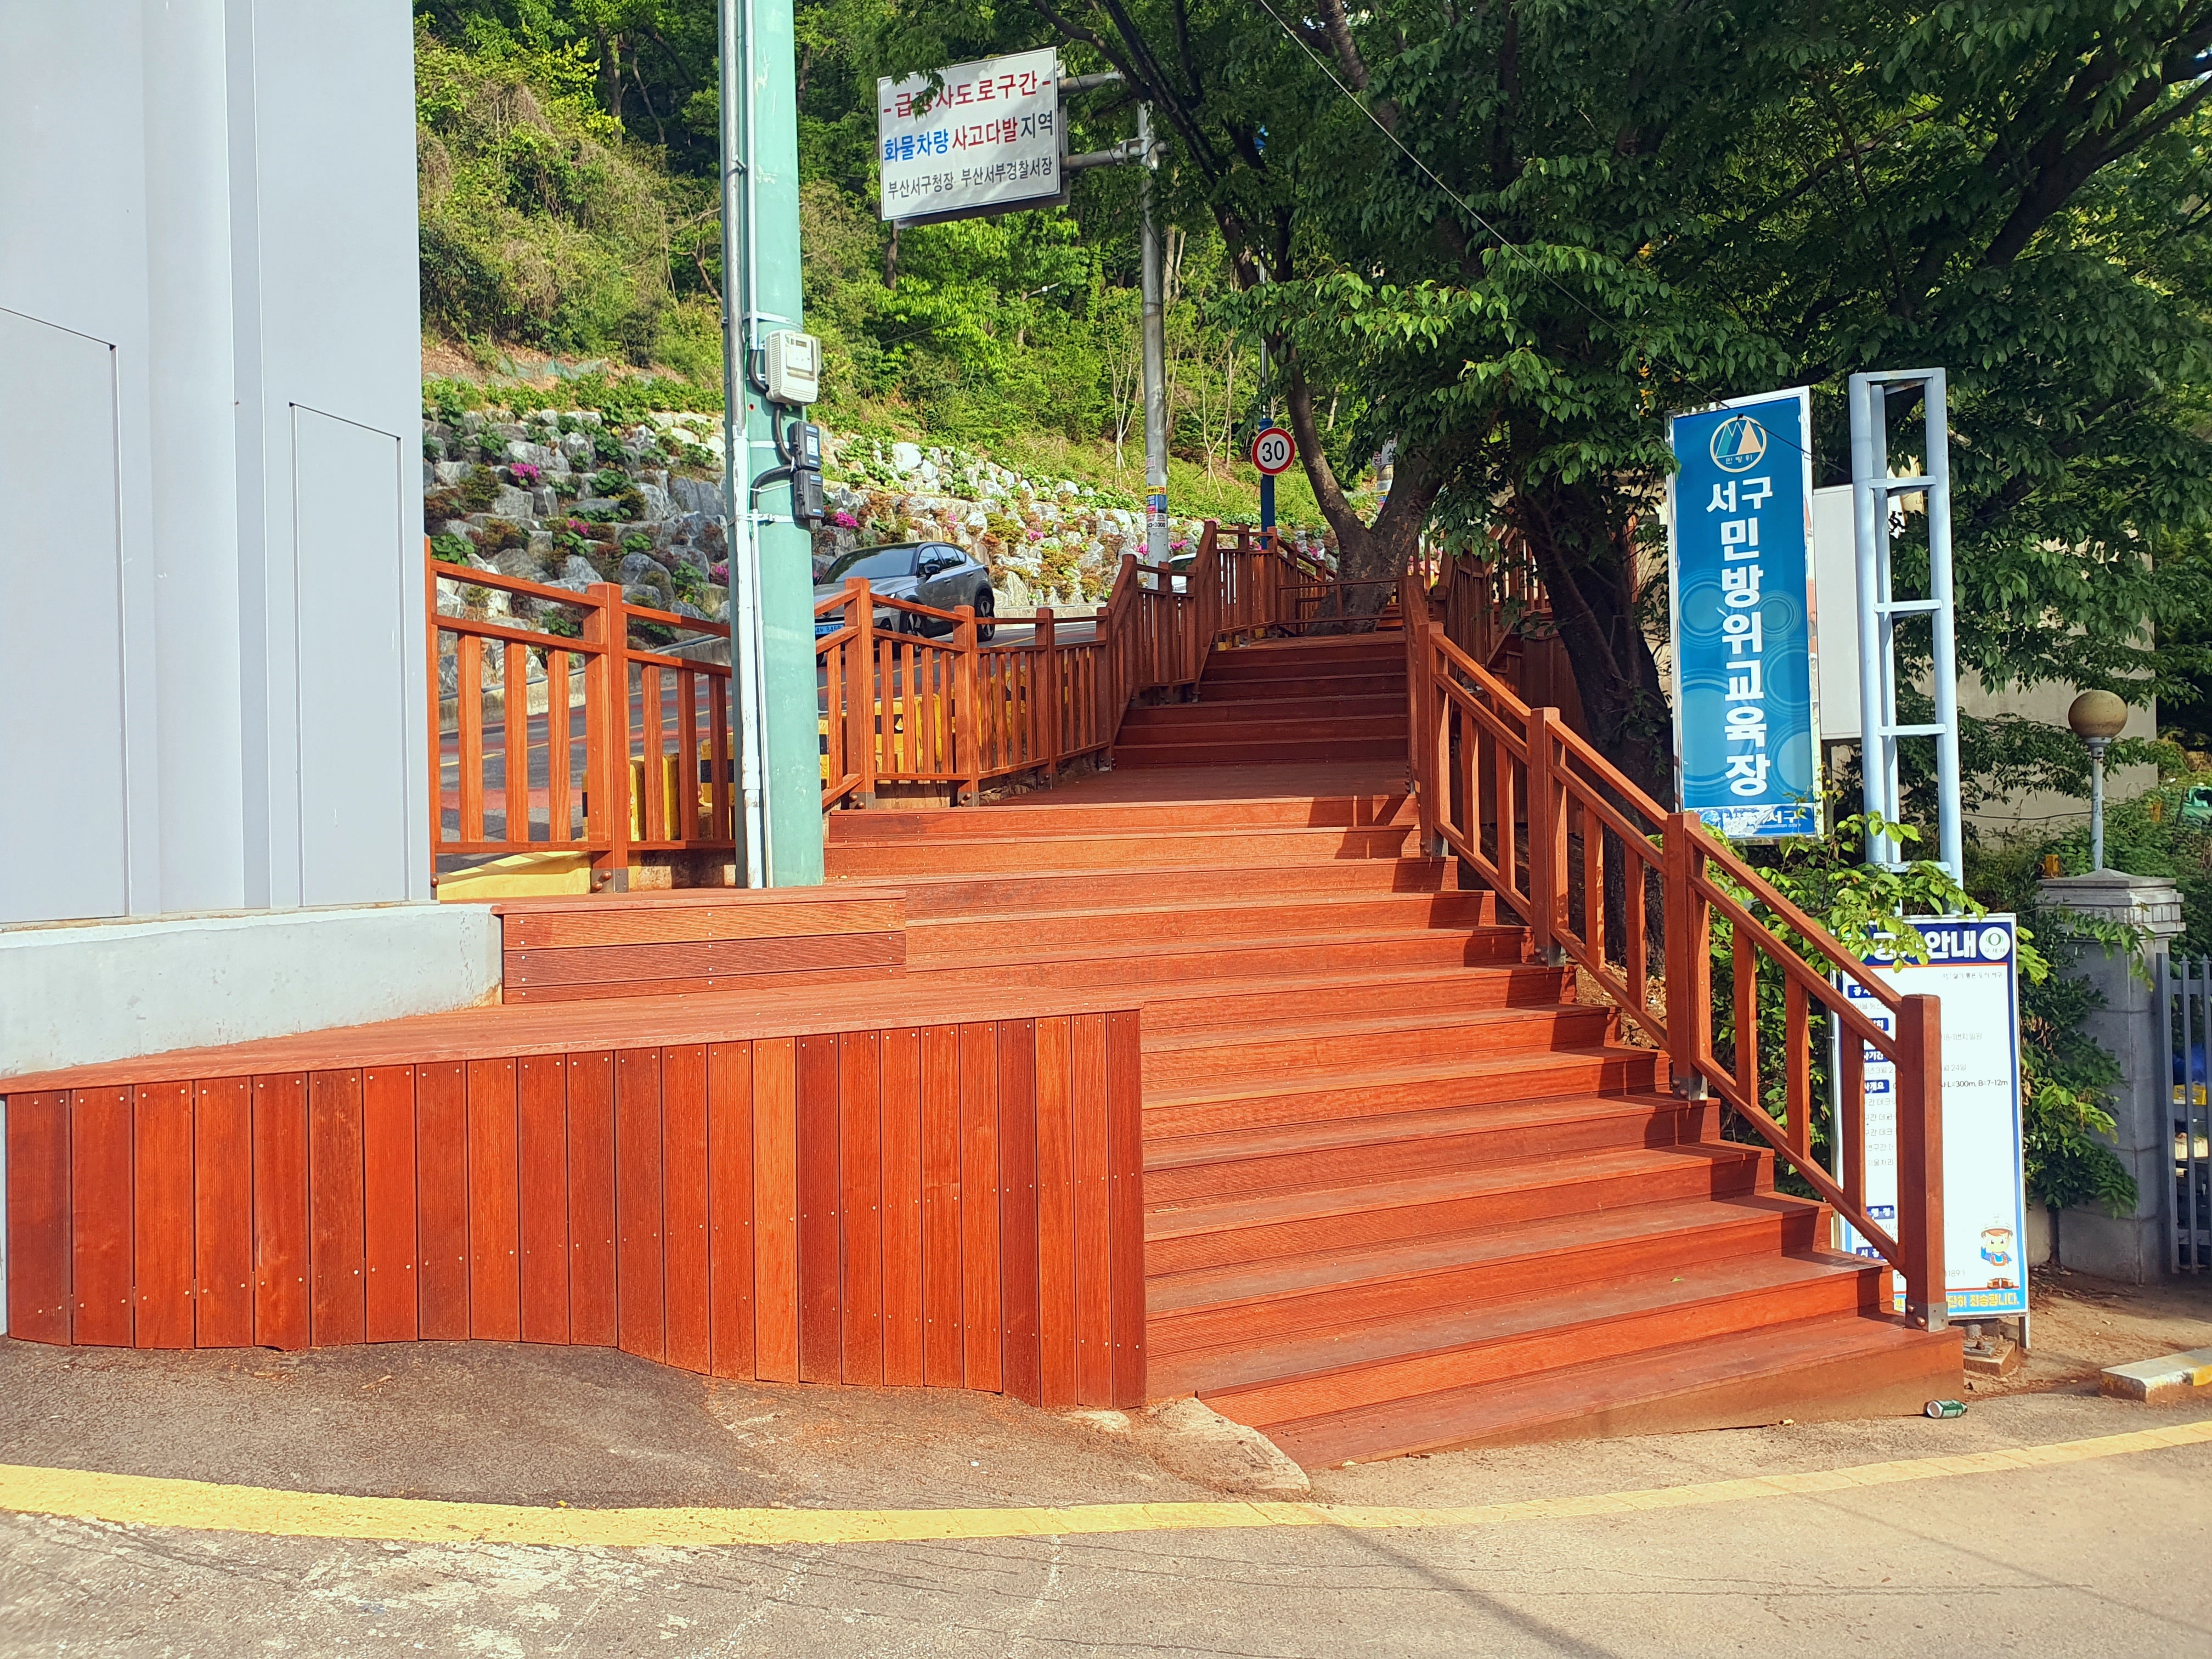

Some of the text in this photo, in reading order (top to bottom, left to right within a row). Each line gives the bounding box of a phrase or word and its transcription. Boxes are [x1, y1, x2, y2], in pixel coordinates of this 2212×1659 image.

[884, 128, 949, 162] 화물차량
[888, 156, 1052, 200] 부산서구청장 부산서부경찰서장
[1262, 441, 1285, 462] 30
[1706, 476, 1773, 513] 서구
[1720, 517, 1770, 797] 민방위교육장
